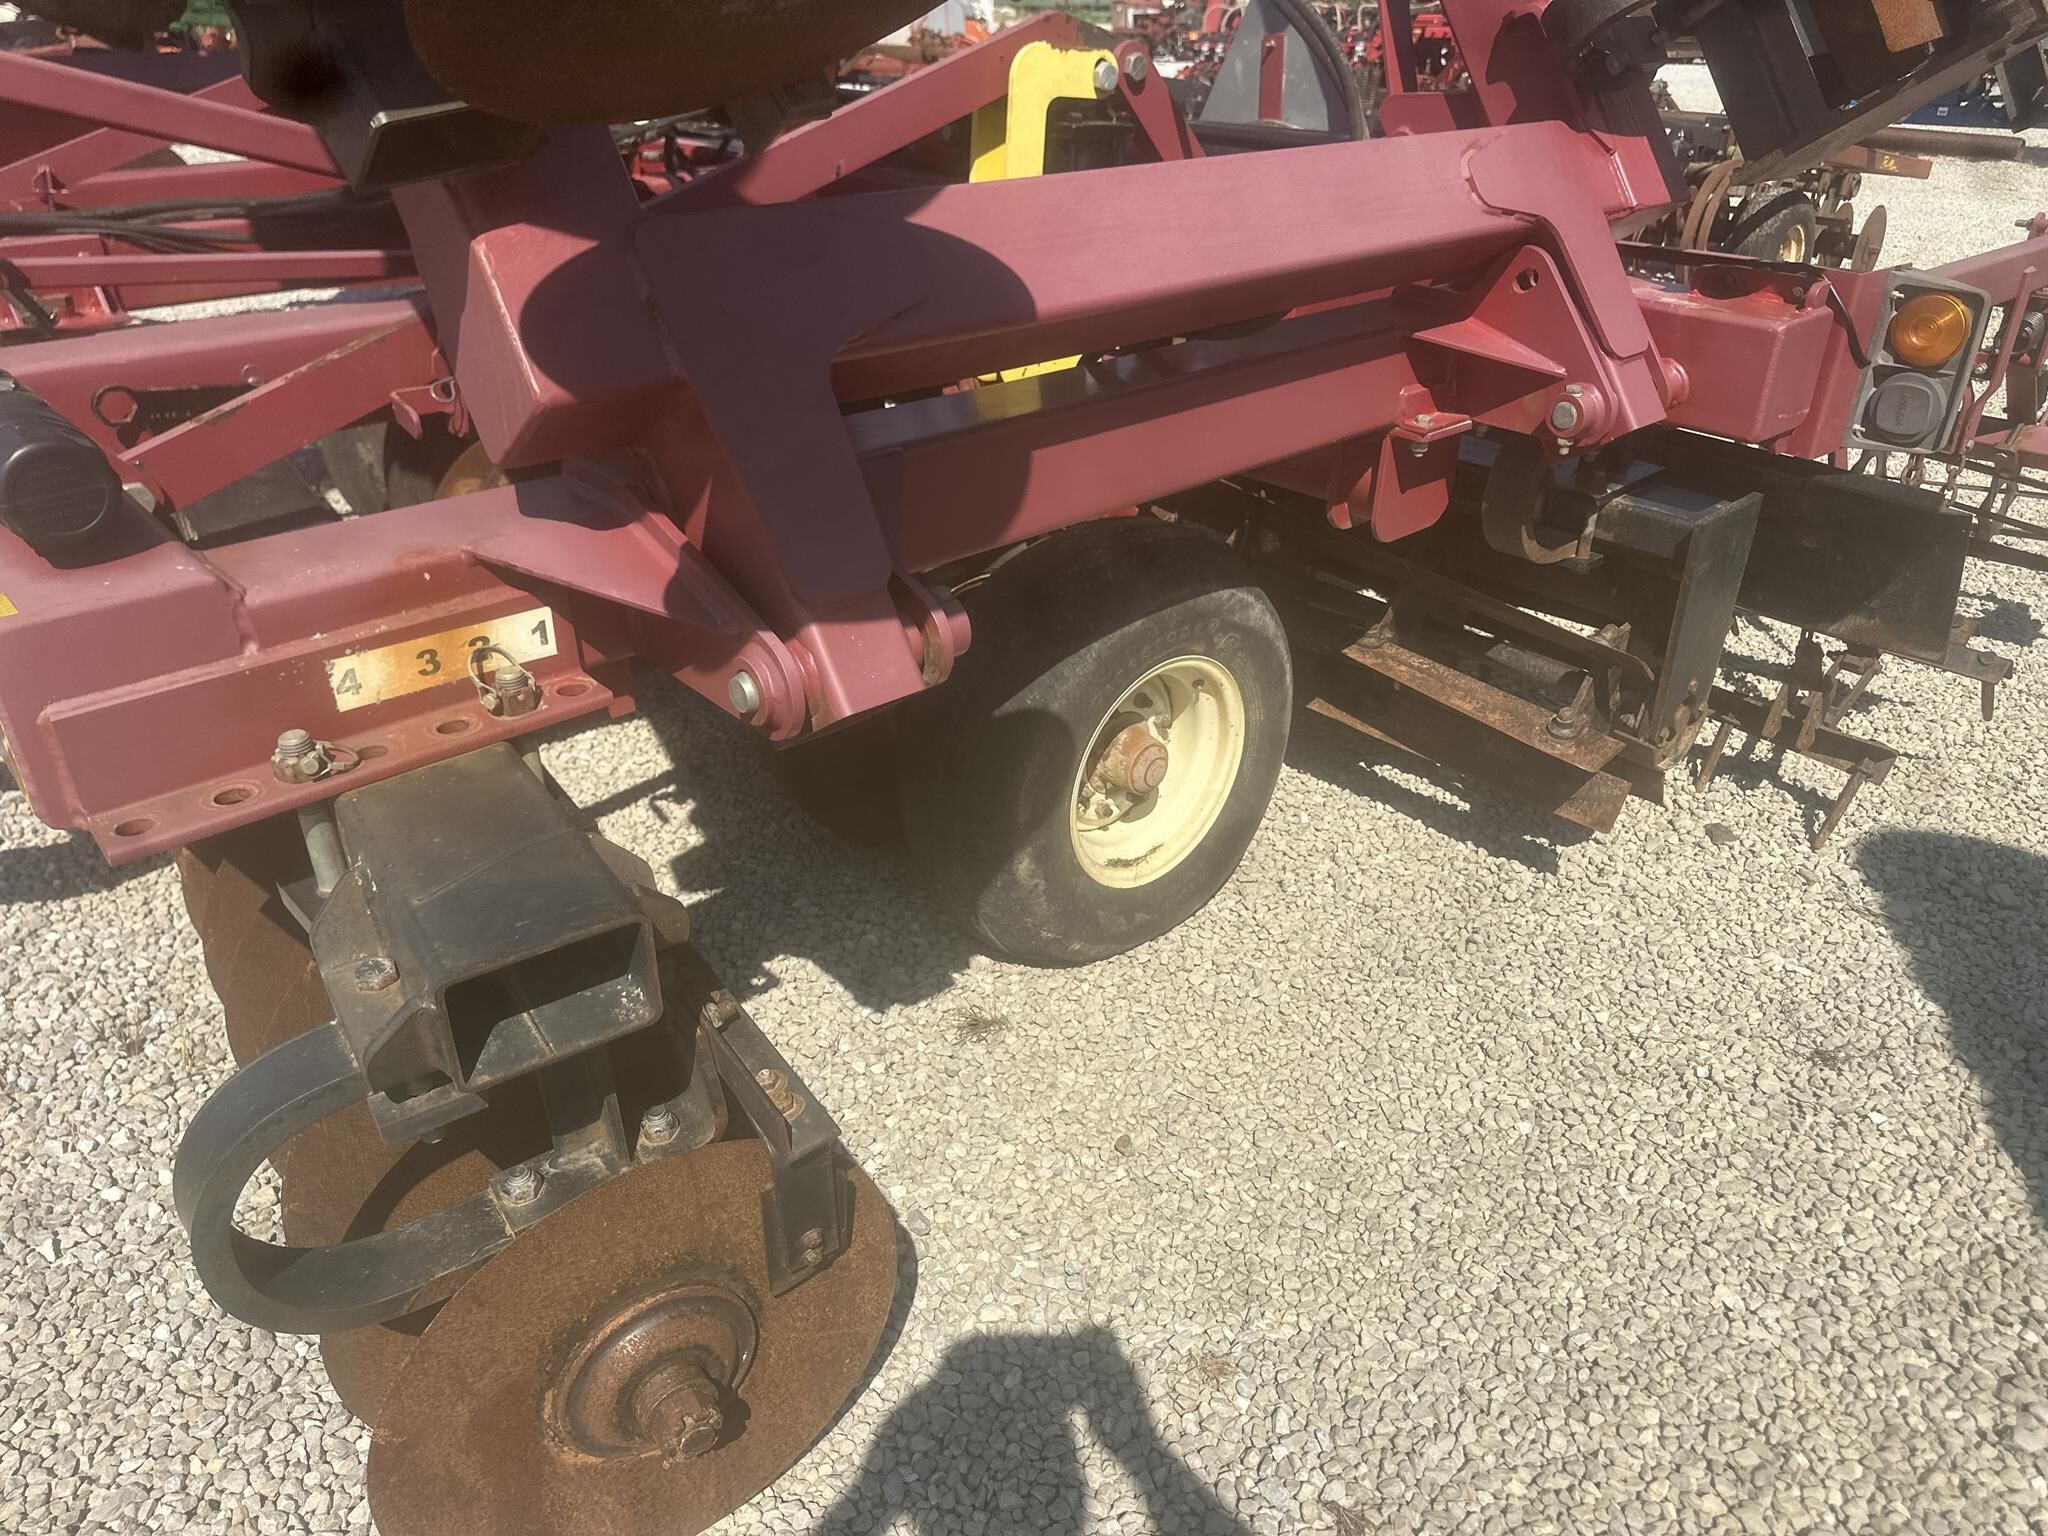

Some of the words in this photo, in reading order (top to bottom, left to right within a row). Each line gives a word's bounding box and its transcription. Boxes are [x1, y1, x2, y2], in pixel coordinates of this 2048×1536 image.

[337, 668, 362, 695] 4
[416, 649, 441, 676] 3
[531, 620, 549, 646] 1
